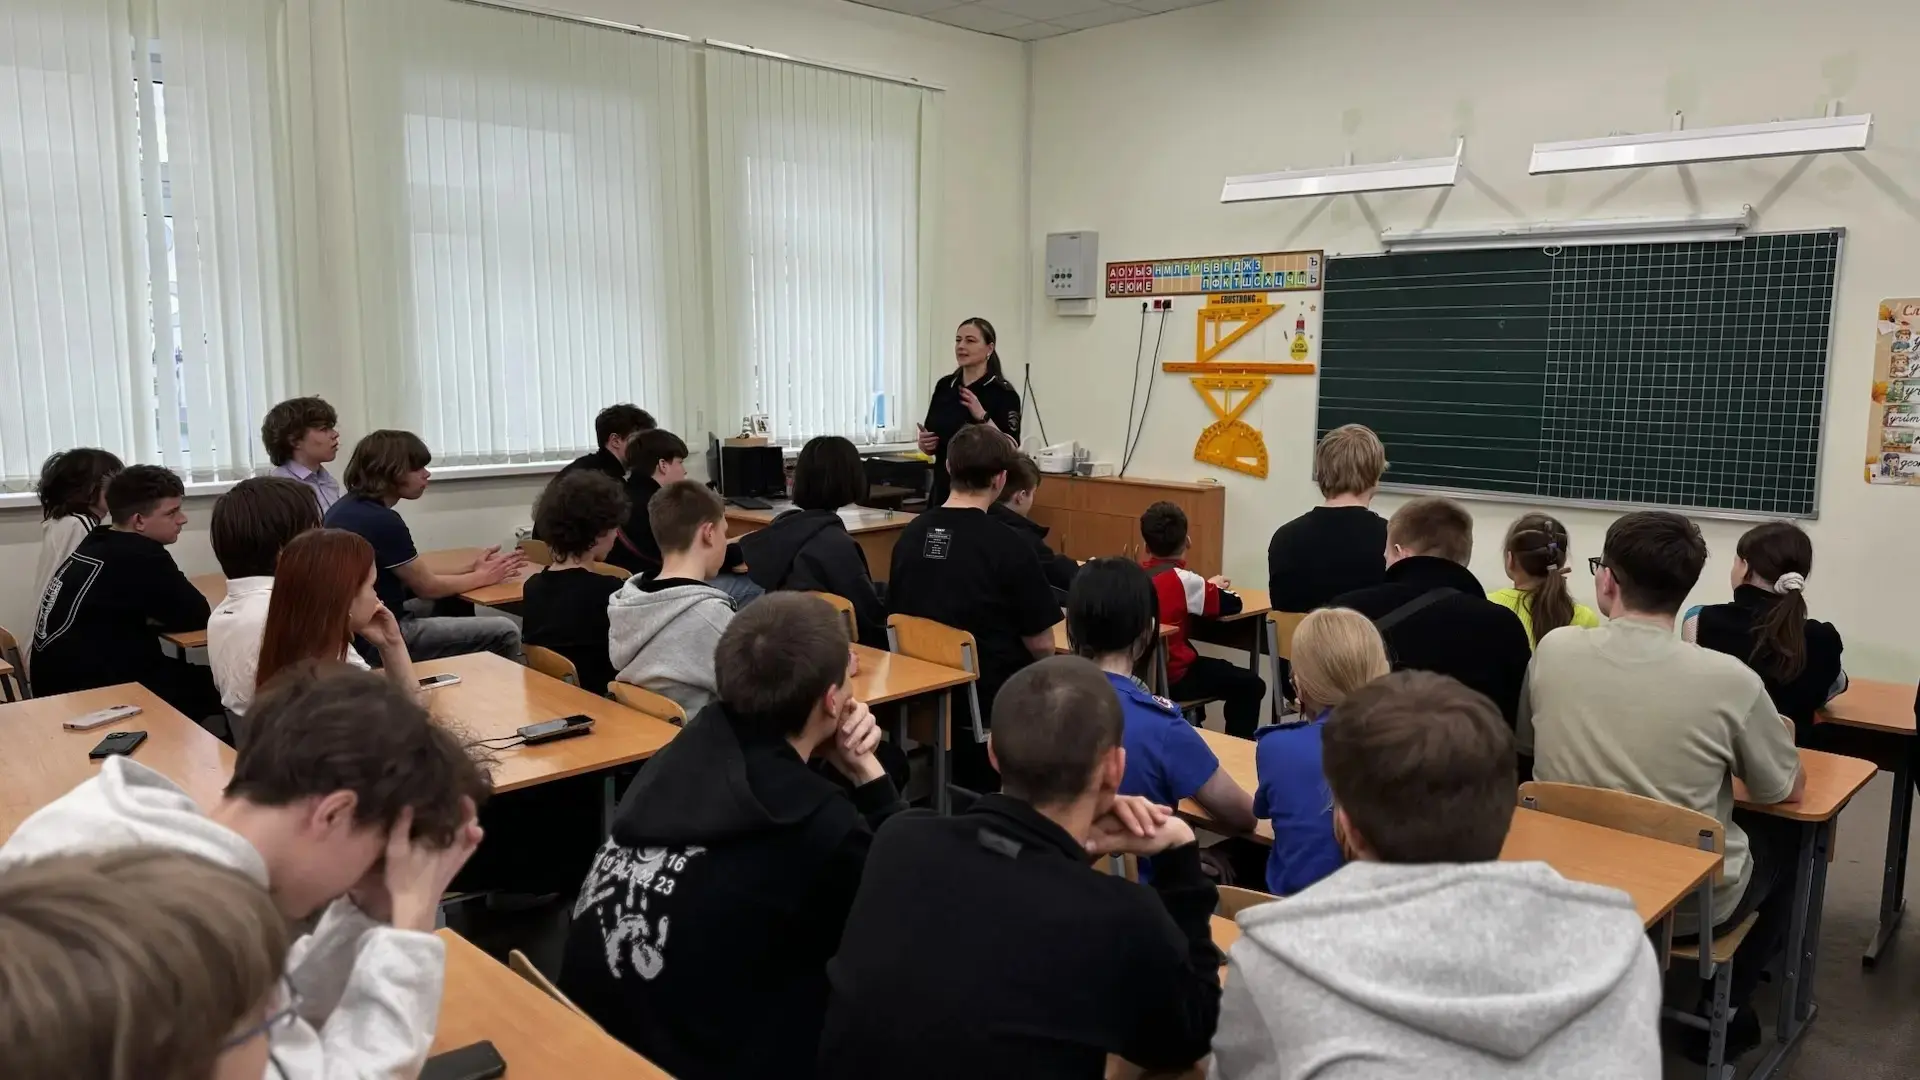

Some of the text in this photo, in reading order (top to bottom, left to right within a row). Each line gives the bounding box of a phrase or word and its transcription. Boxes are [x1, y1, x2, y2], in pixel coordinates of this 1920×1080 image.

[1220, 295, 1256, 304] EDUSTRONG
[667, 853, 687, 872] 16
[654, 876, 675, 895] 23
